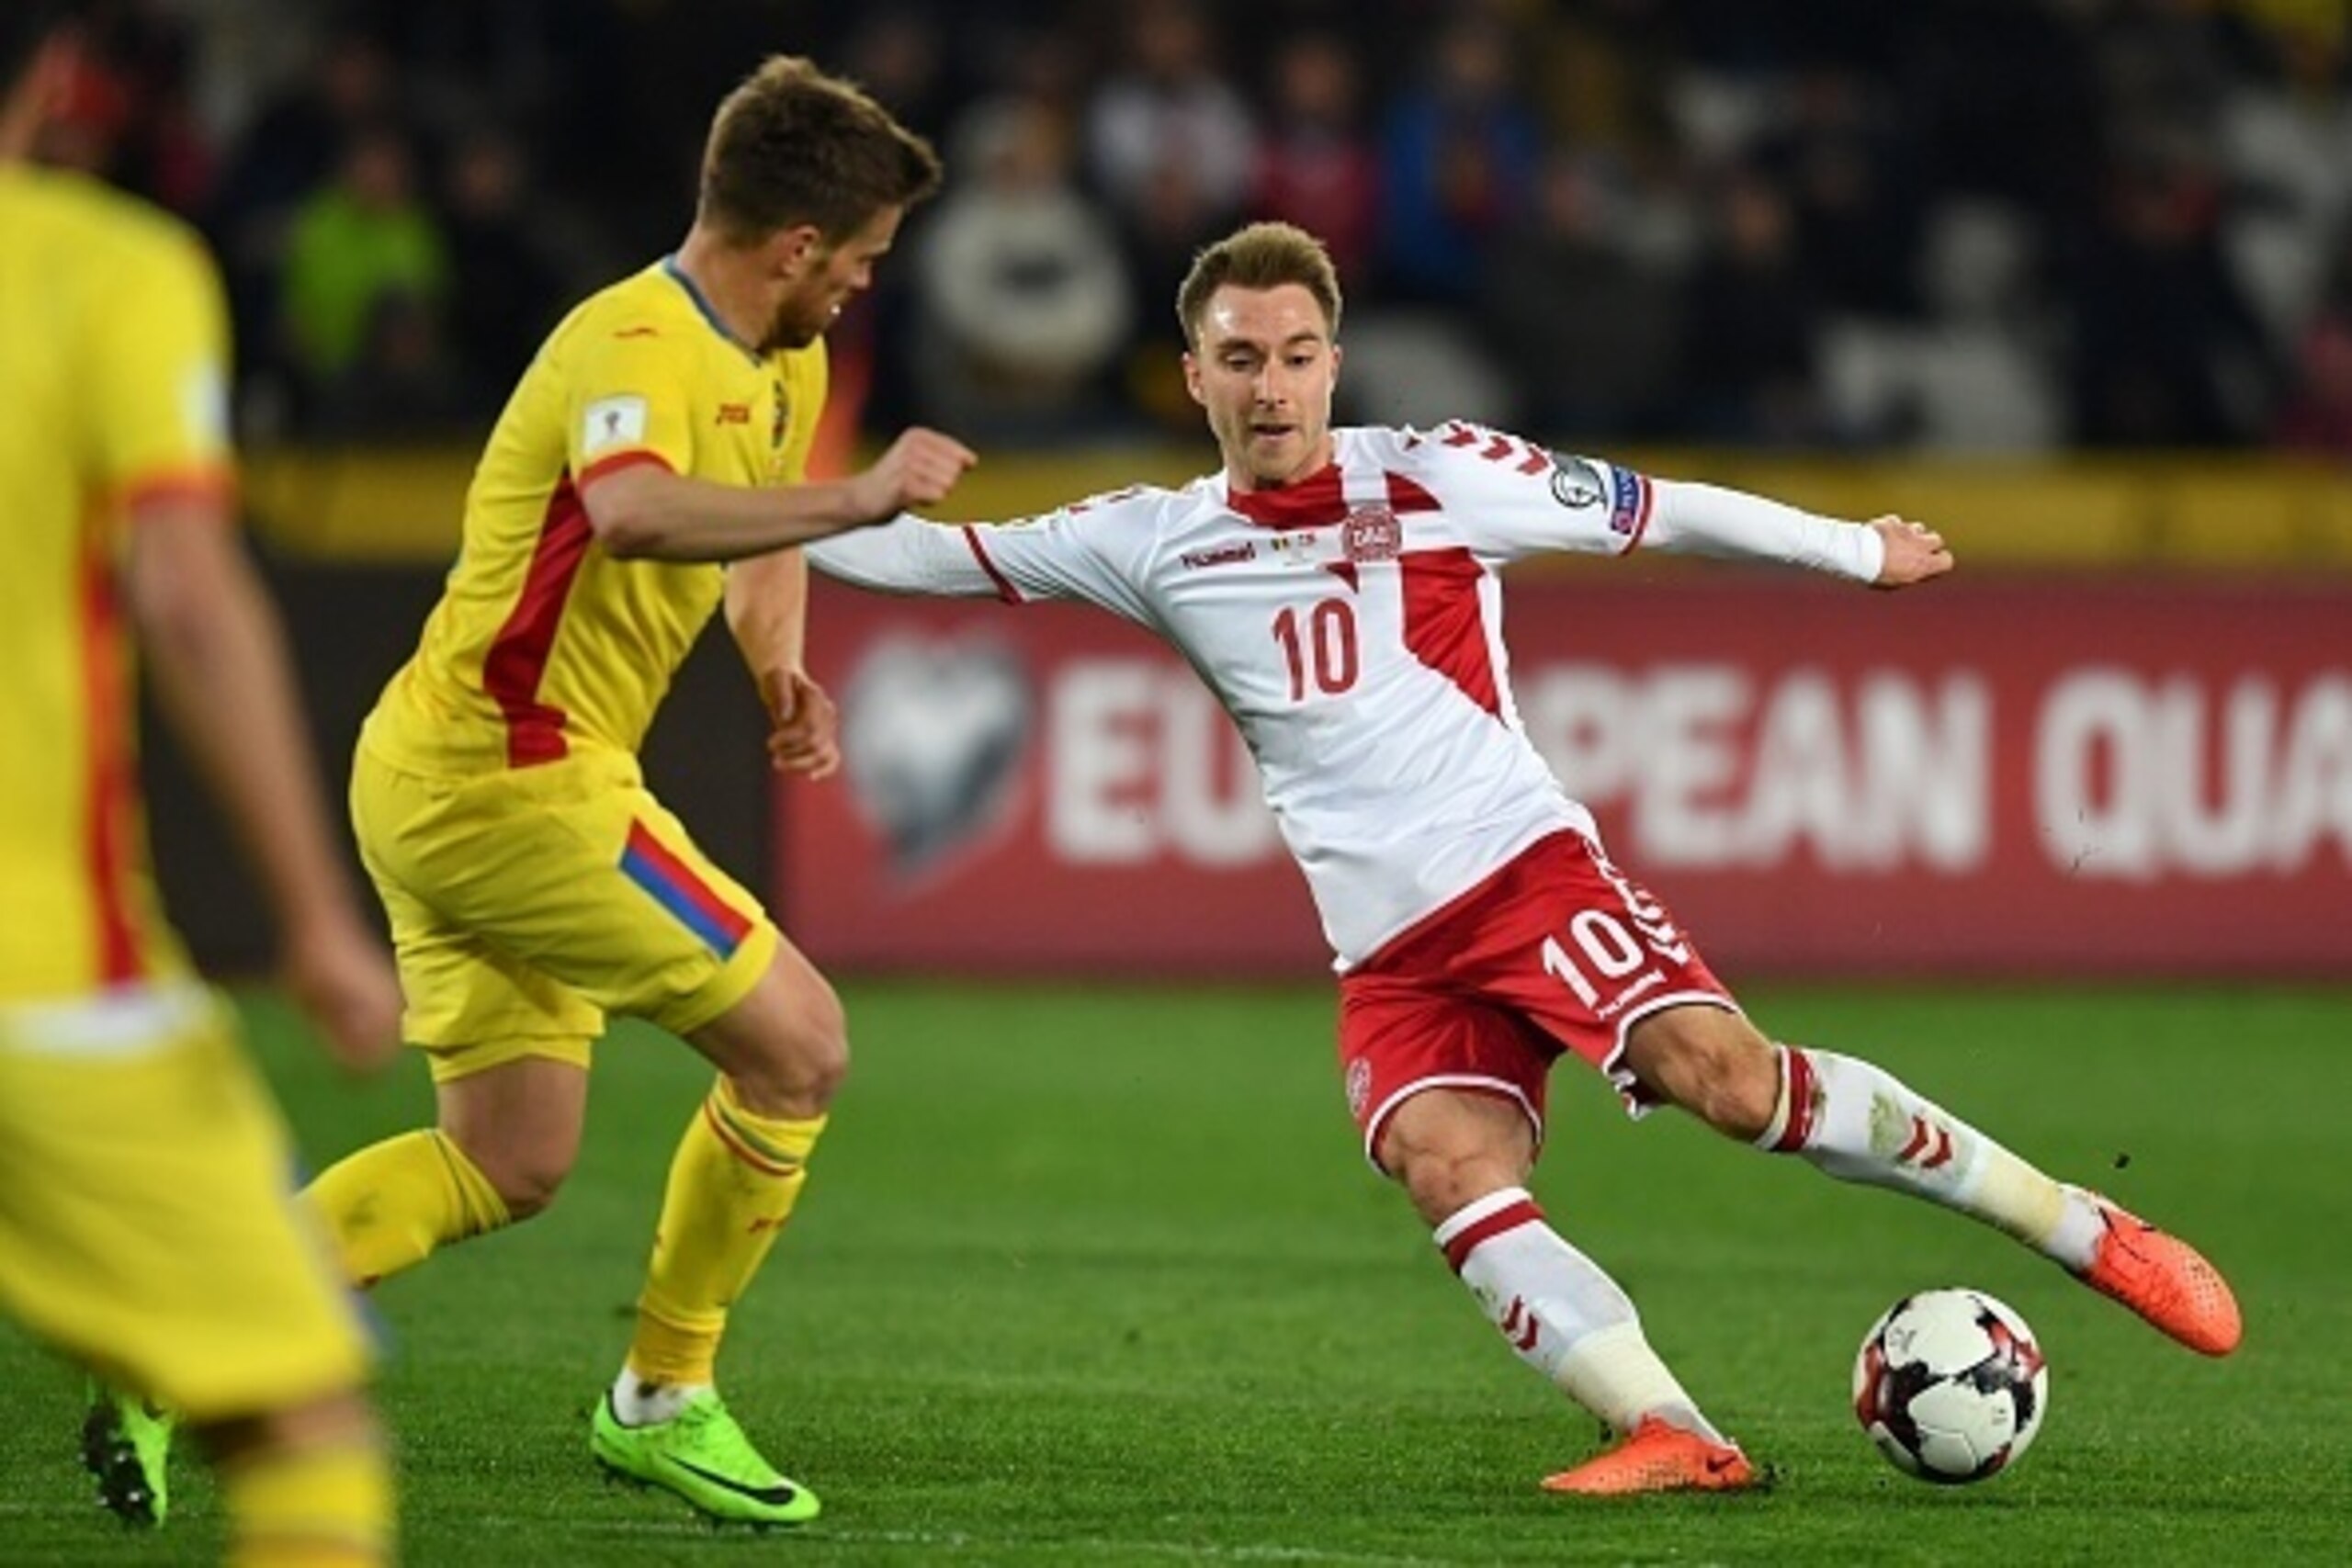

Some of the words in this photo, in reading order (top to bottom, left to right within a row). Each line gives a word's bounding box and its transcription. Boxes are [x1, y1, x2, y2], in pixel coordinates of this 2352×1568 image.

[1272, 597, 1359, 702] 10
[1046, 660, 1990, 873] EUPEAN
[1541, 909, 1645, 1010] 10
